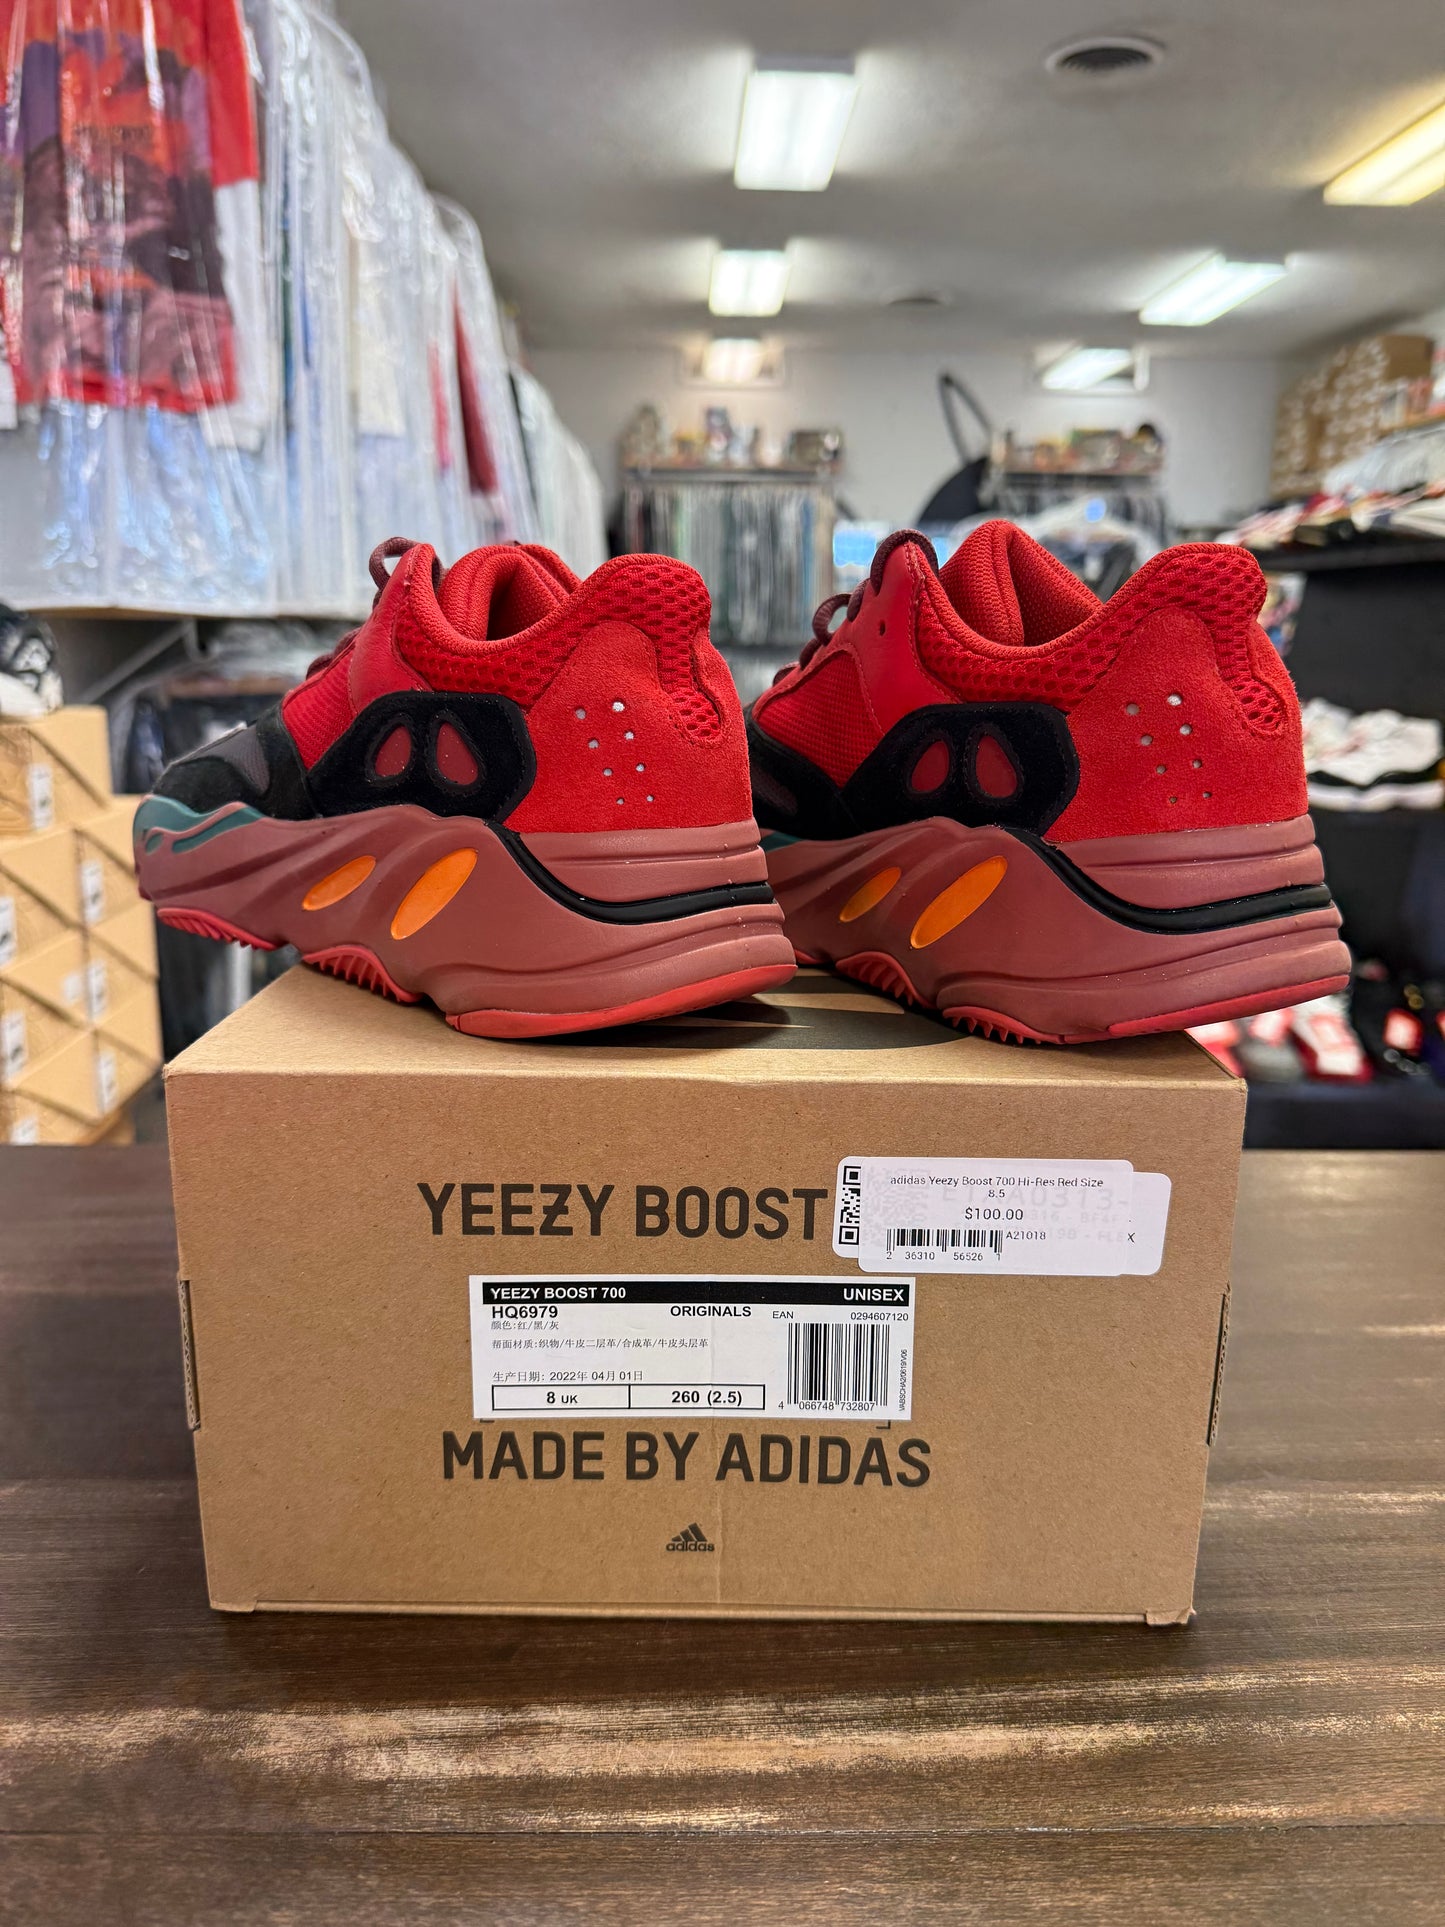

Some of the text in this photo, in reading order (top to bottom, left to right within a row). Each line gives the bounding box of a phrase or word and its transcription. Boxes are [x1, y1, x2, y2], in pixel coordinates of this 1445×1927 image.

[890, 1175, 1104, 1187] adidas Yeezy Boost 700 Hi-Res Red Size
[988, 1189, 1005, 1198] 8.5
[417, 1183, 828, 1240] YEEZY BOOST
[964, 1206, 1024, 1221] $100.00
[1005, 1231, 1046, 1241] A21018
[886, 1251, 893, 1260] 2
[905, 1251, 936, 1261] 36310
[953, 1252, 984, 1261] 56526
[490, 1287, 626, 1300] YEEZY BOOST 700
[843, 1288, 904, 1301] UNISEX
[491, 1305, 559, 1319] HQ6979
[670, 1305, 752, 1317] ORIGINALS
[772, 1311, 794, 1319] EAN
[850, 1312, 909, 1321] 0294607120
[546, 1391, 579, 1404] 8 UK
[671, 1390, 743, 1406] 260 (2.5)
[778, 1402, 875, 1411] 4 066748 732807
[443, 1431, 931, 1487] MADE BY ADIDAS
[665, 1540, 715, 1552] adidas
